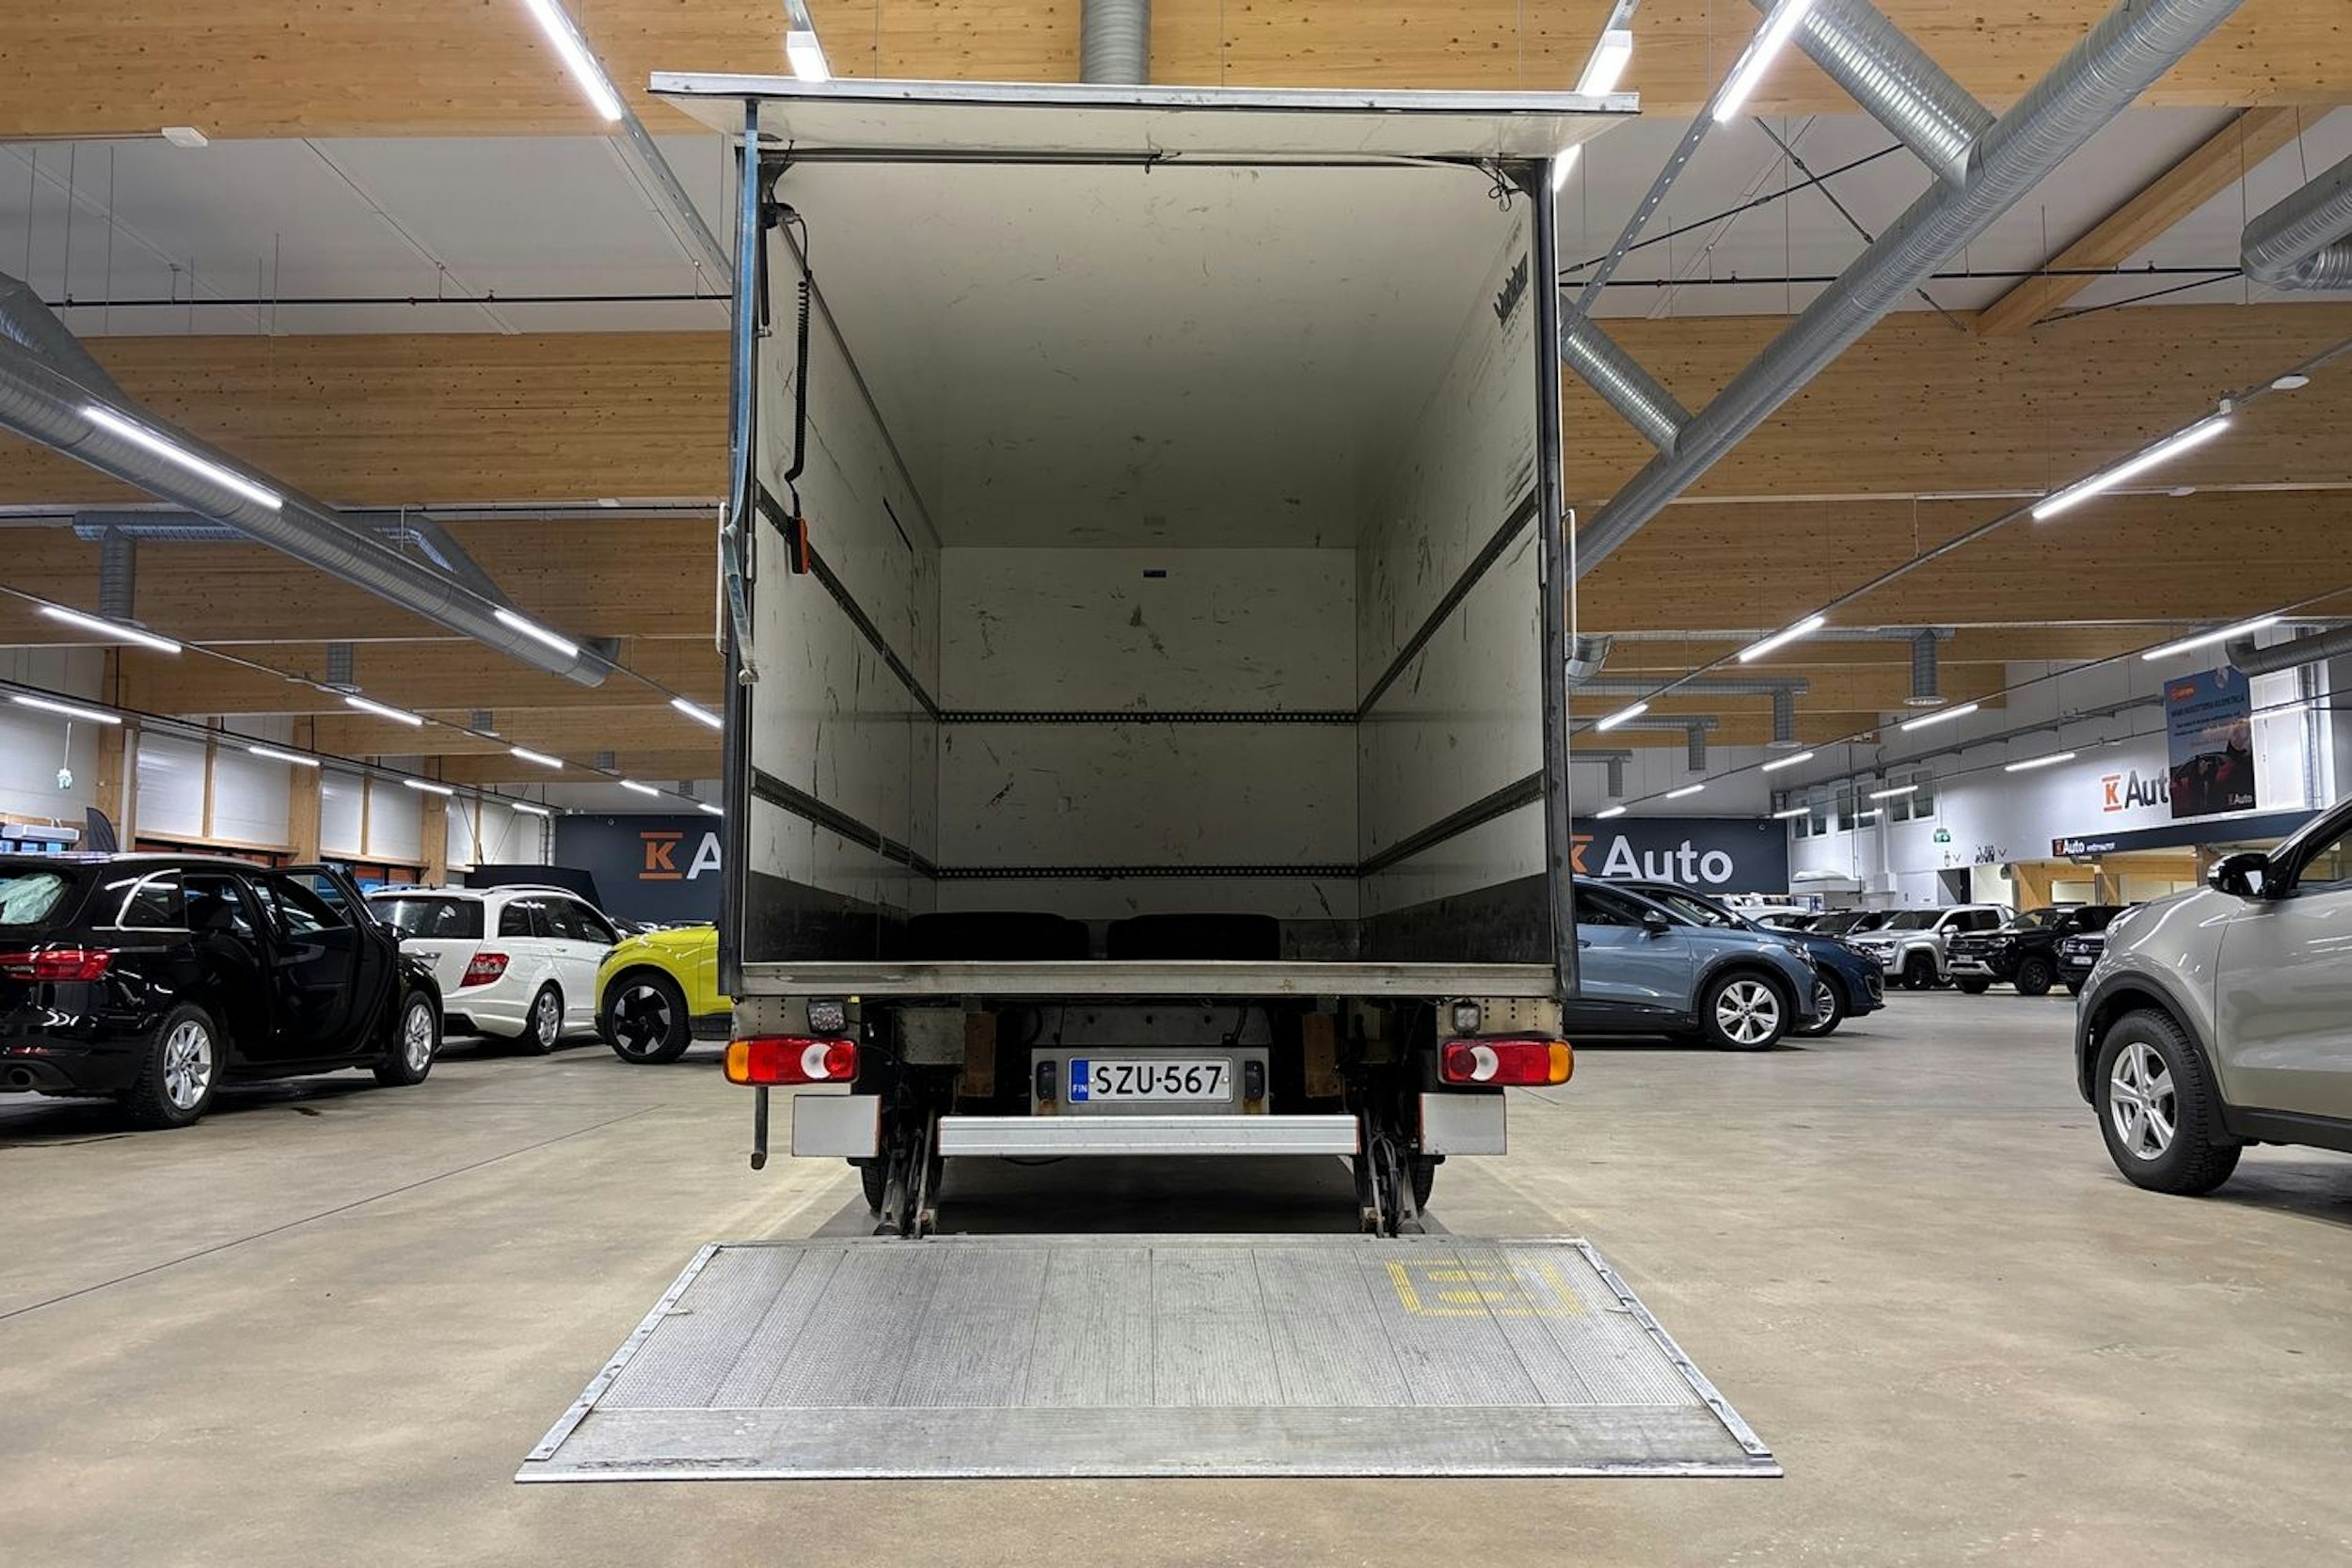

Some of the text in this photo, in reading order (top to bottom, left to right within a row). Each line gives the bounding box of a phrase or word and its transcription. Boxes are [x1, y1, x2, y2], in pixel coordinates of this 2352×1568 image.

[2234, 794, 2252, 805] Auto
[2063, 839, 2085, 854] Auto
[1601, 834, 1734, 884] Auto
[1095, 1066, 1222, 1095] SZU-567
[1073, 1084, 1088, 1093] FIN
